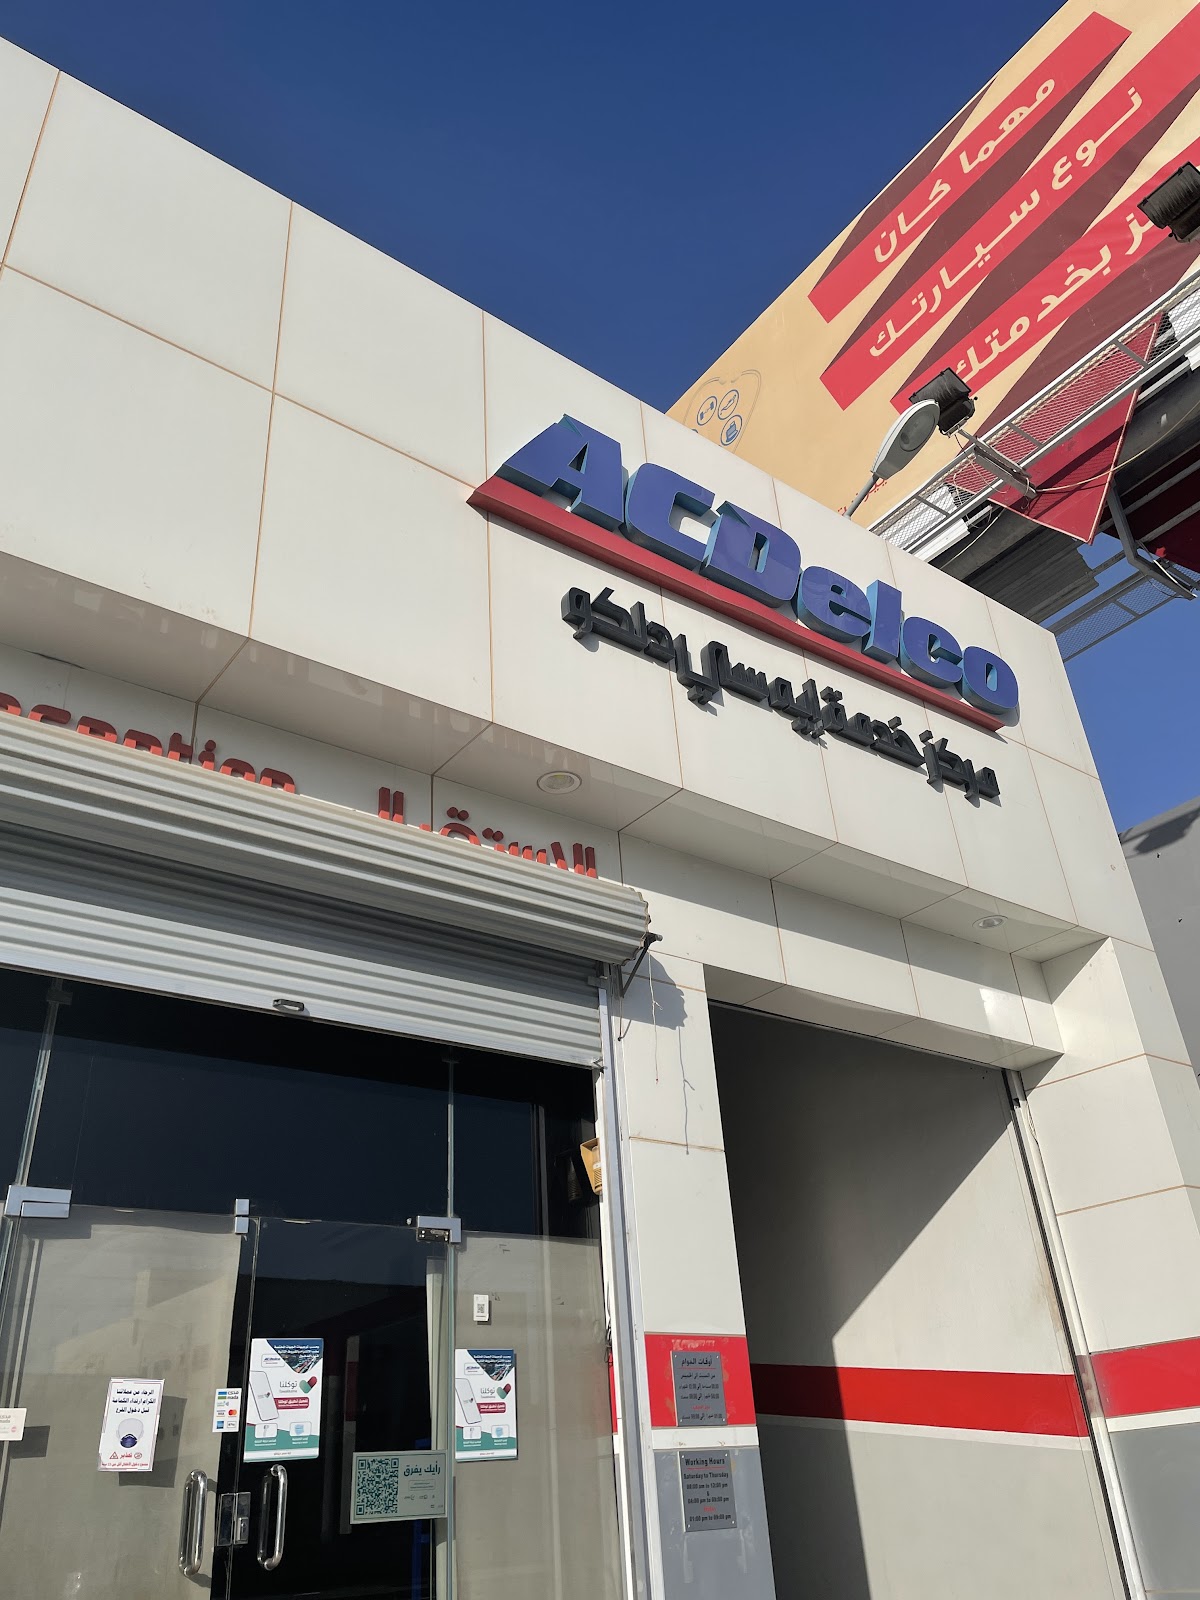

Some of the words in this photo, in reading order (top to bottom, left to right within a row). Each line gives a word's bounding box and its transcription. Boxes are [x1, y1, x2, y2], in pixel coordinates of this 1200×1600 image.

[959, 79, 1055, 173] مهما
[1052, 87, 1143, 190] نوع
[874, 178, 951, 262] كان
[869, 189, 1040, 357] سيارتك
[498, 412, 1020, 715] ACDelco
[820, 686, 926, 768] خدمة
[919, 730, 1000, 799] مركز
[403, 1464, 422, 1477] يفرق
[424, 1460, 441, 1475] رأيك
[685, 1458, 708, 1466] Working
